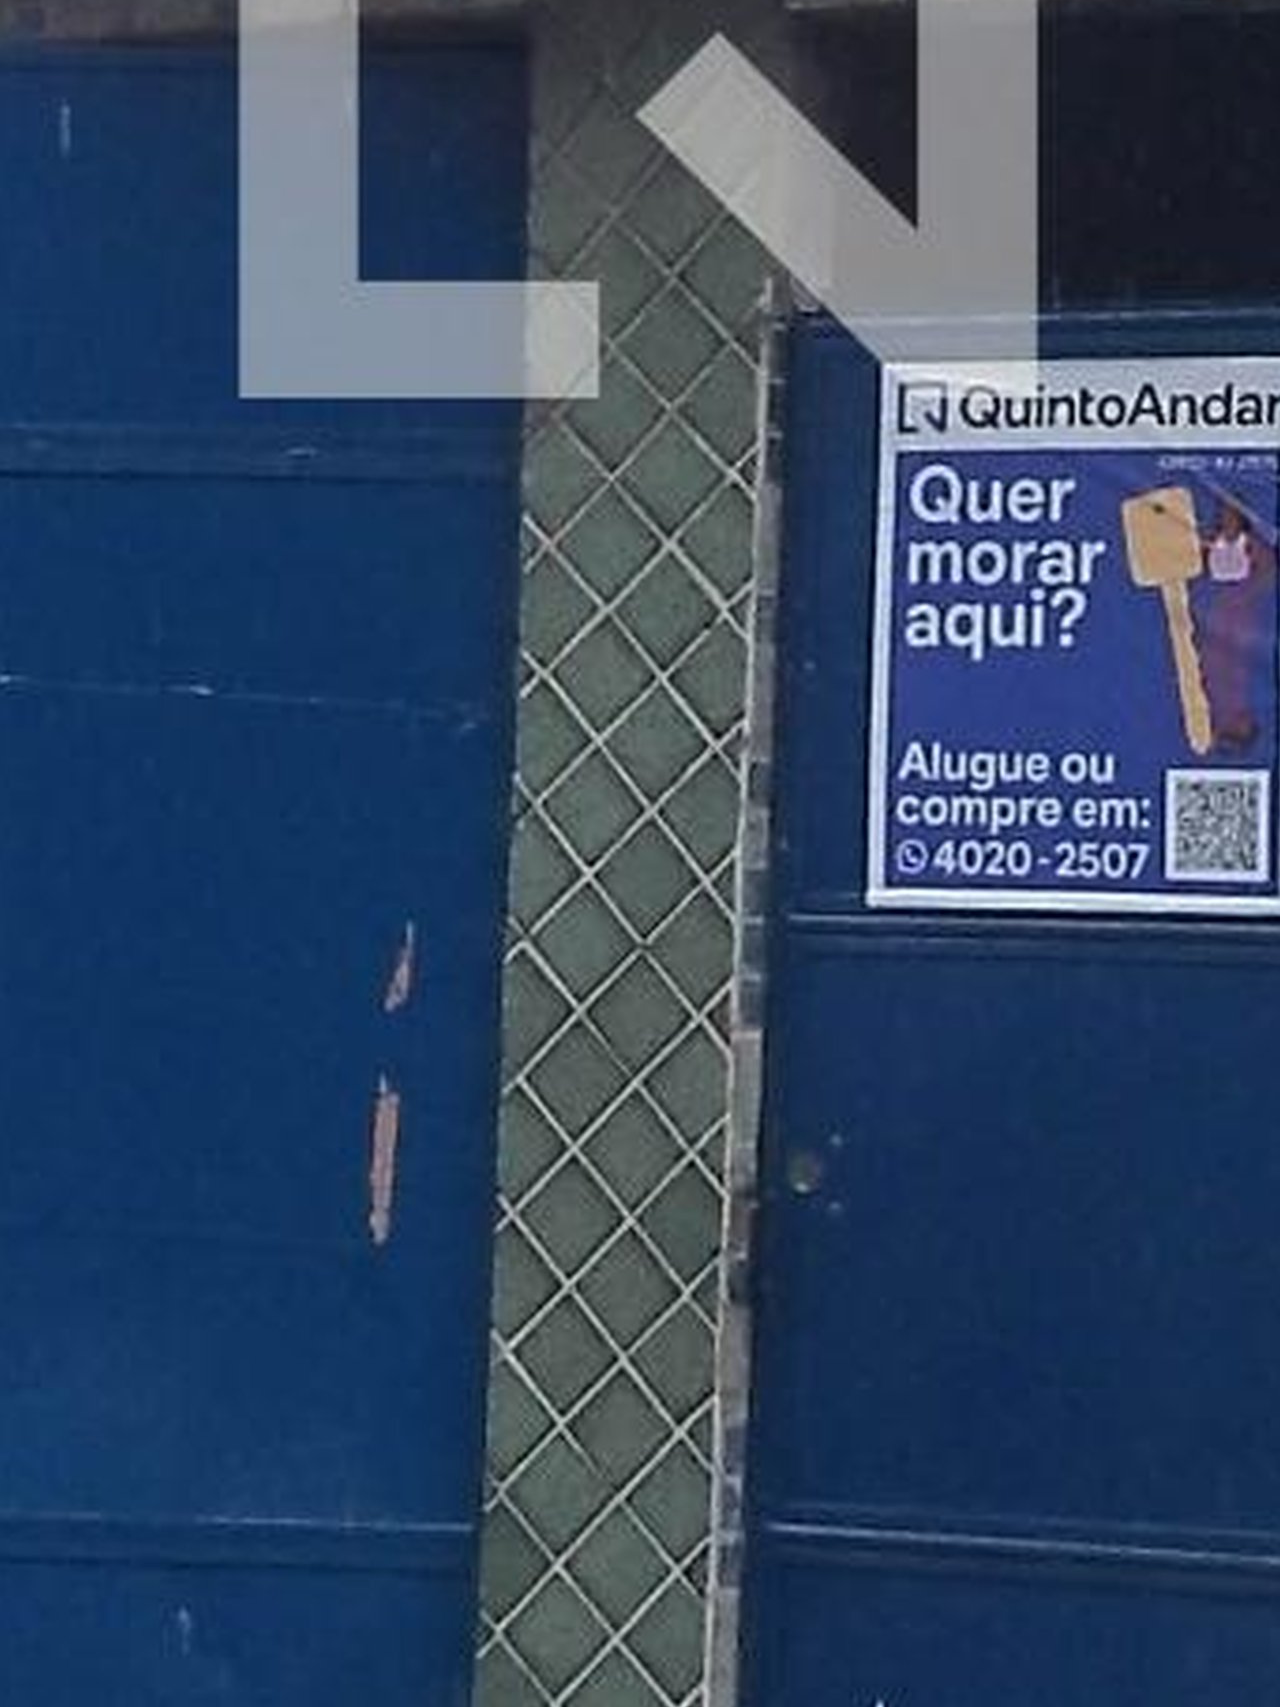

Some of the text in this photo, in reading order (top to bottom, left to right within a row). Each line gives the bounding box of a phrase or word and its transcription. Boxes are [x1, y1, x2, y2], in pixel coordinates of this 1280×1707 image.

[908, 463, 1076, 524] Quer
[907, 538, 1106, 587] morar
[904, 590, 1088, 662] aqui?
[896, 742, 1115, 793] Alugue ou
[895, 794, 1151, 843] compre em:
